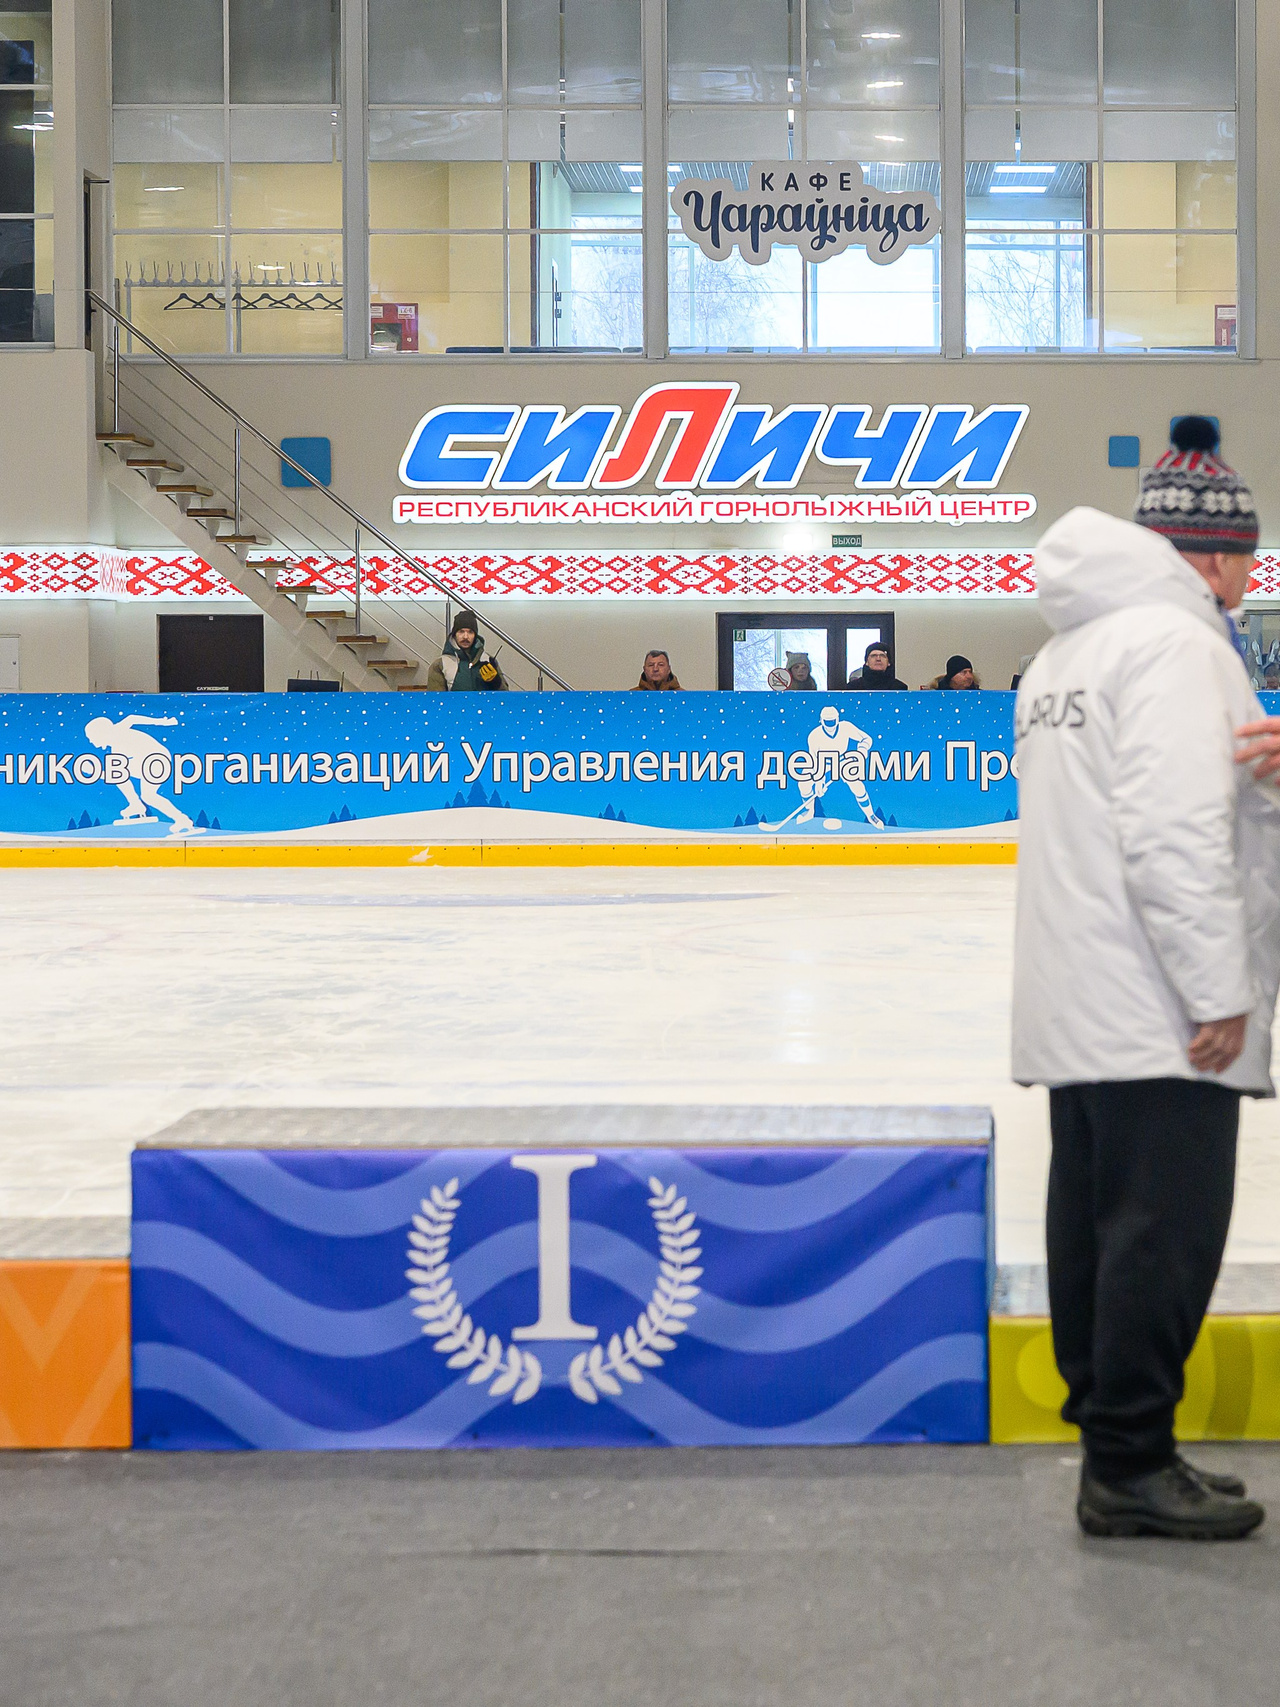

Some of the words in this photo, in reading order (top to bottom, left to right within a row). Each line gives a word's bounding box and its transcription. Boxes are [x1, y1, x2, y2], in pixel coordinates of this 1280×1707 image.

[760, 172, 852, 192] КАФЕ
[683, 190, 930, 254] Чараўніца
[399, 497, 692, 517] РЕСПУБЛИКАНСКИЙ
[701, 496, 932, 517] ГОРНОЛЫЖНЫЙ
[940, 500, 1030, 519] ЦЕНТР
[832, 536, 862, 546] ВЫХОД
[141, 741, 450, 795] организаций
[460, 741, 746, 793] Управления
[756, 750, 931, 790] делами
[511, 1154, 599, 1341] I
